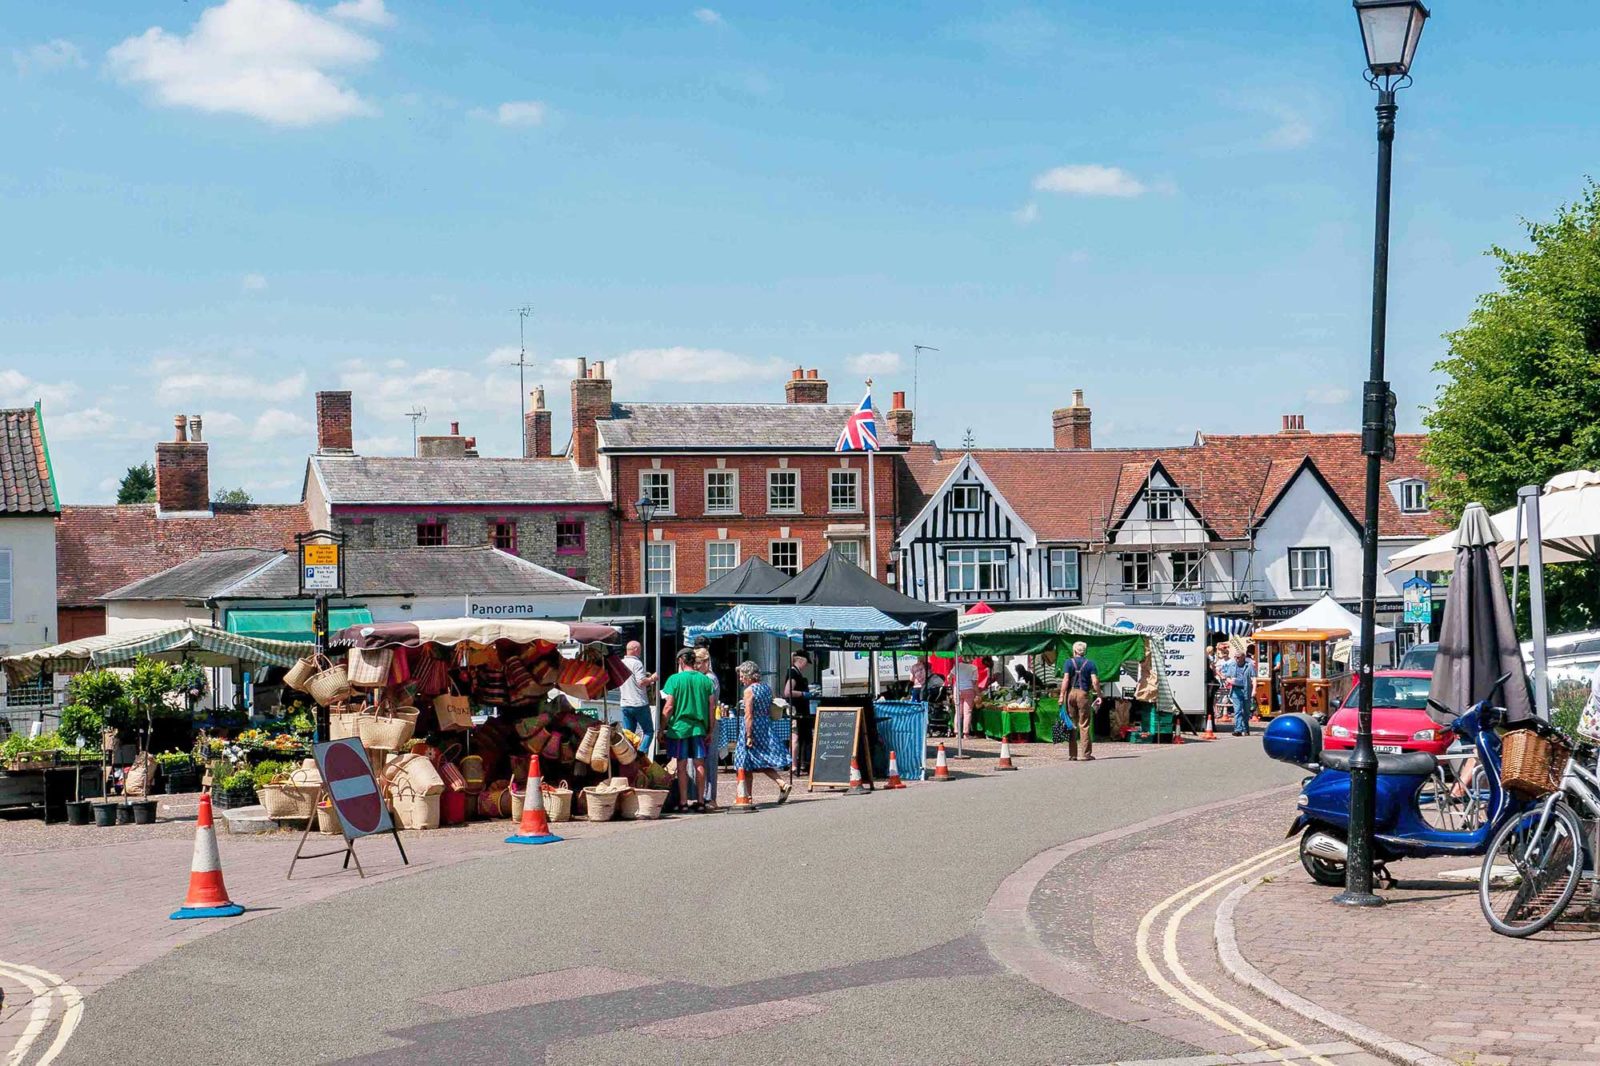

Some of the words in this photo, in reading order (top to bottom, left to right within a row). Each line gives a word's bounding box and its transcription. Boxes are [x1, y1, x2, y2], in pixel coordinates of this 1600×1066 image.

[472, 604, 533, 615] Panorama
[1135, 623, 1165, 634] Darren
[1166, 624, 1195, 634] Smith
[849, 633, 862, 641] free
[1164, 633, 1196, 643] NGER
[844, 640, 882, 650] barbeque
